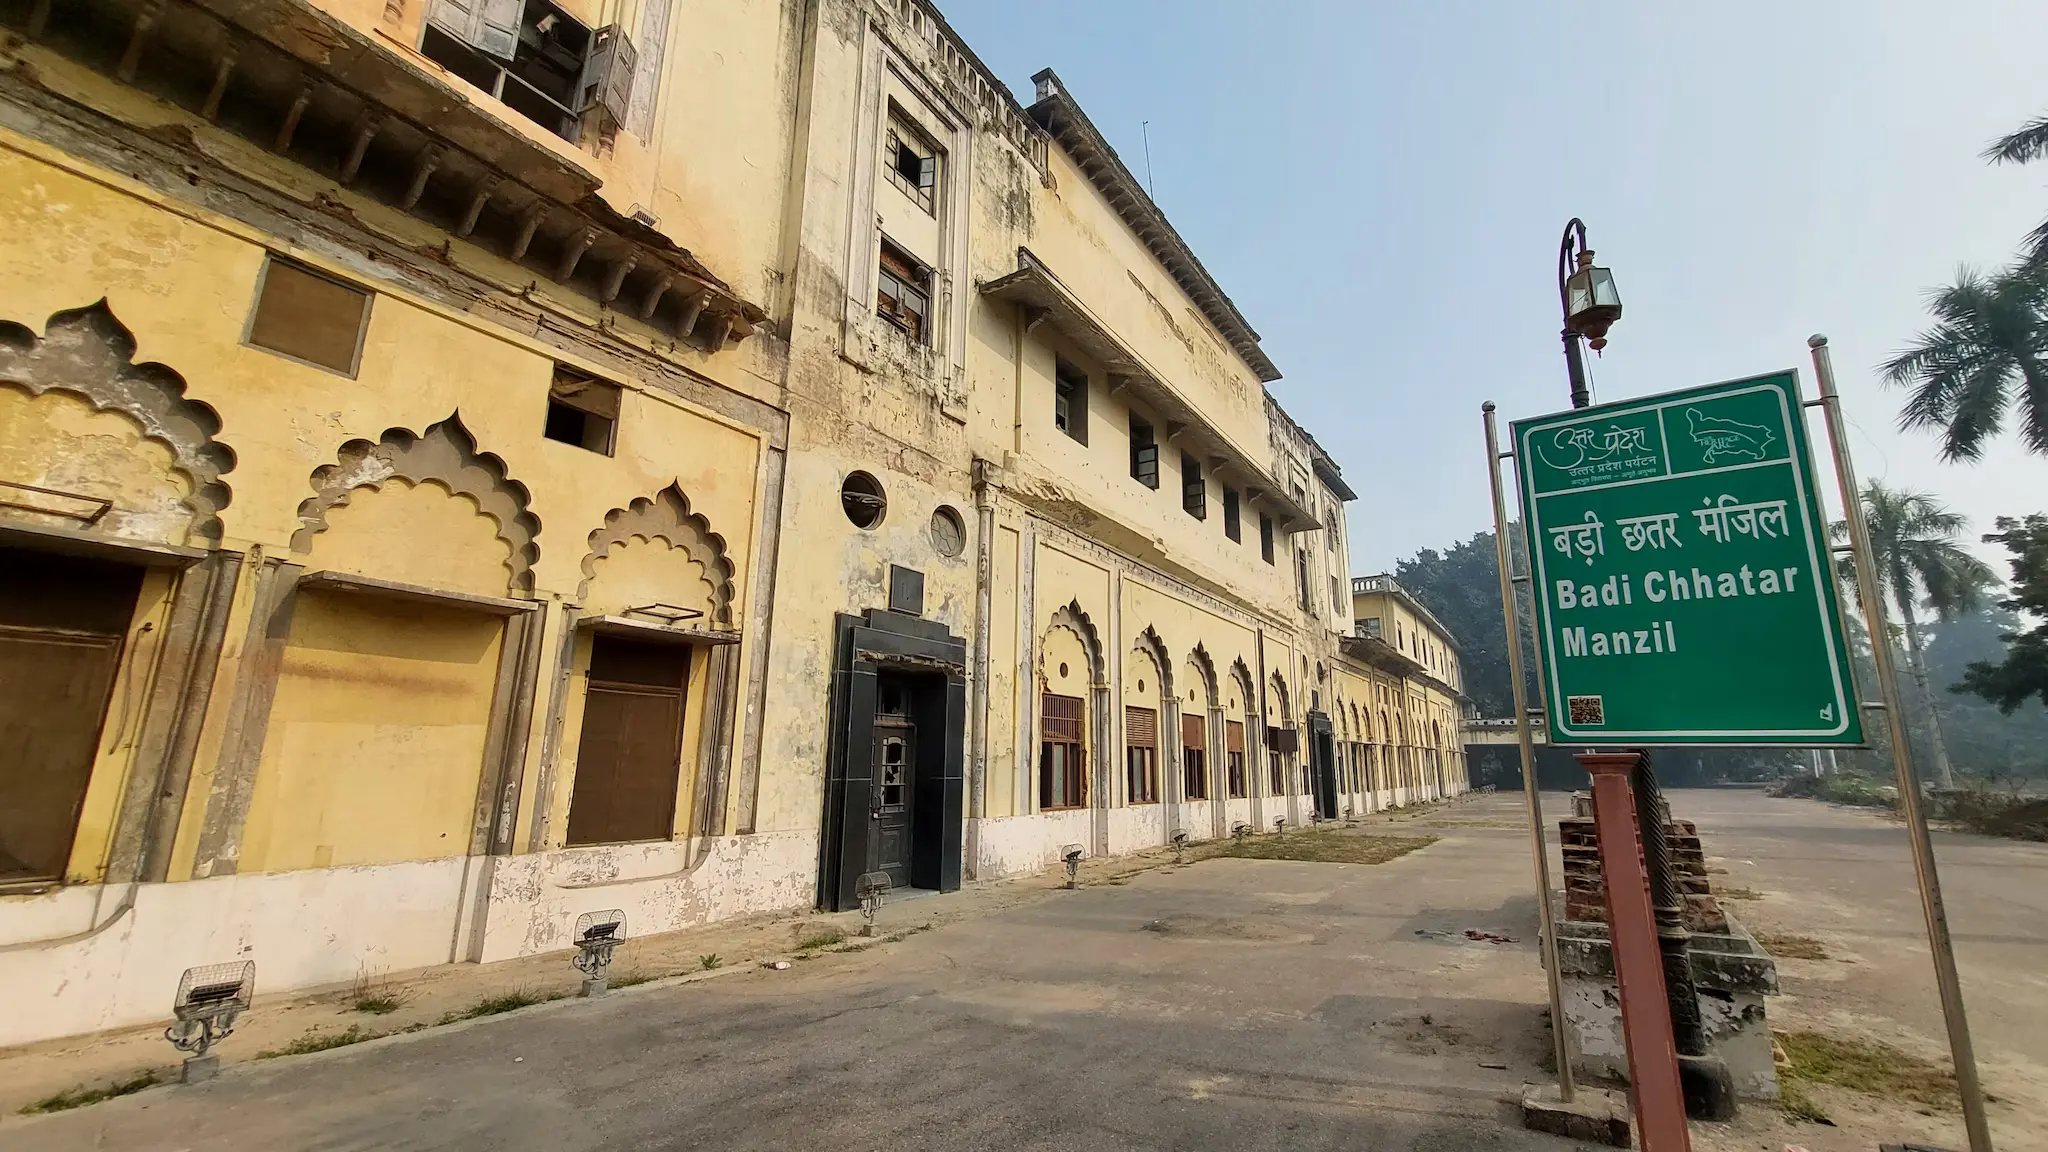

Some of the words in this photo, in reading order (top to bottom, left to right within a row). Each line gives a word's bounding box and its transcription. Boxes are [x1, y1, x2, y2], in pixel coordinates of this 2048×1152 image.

[1568, 465, 1595, 477] उत्तर
[1597, 460, 1622, 473] प्रदेश
[1624, 455, 1657, 469] पर्यटन
[1548, 510, 1605, 566] बड़ी
[1616, 512, 1683, 551] छतर
[1691, 494, 1790, 544] मंजिल
[1556, 574, 1632, 609] Badi
[1644, 563, 1798, 603] Chhatar
[1562, 620, 1677, 657] Manzil
